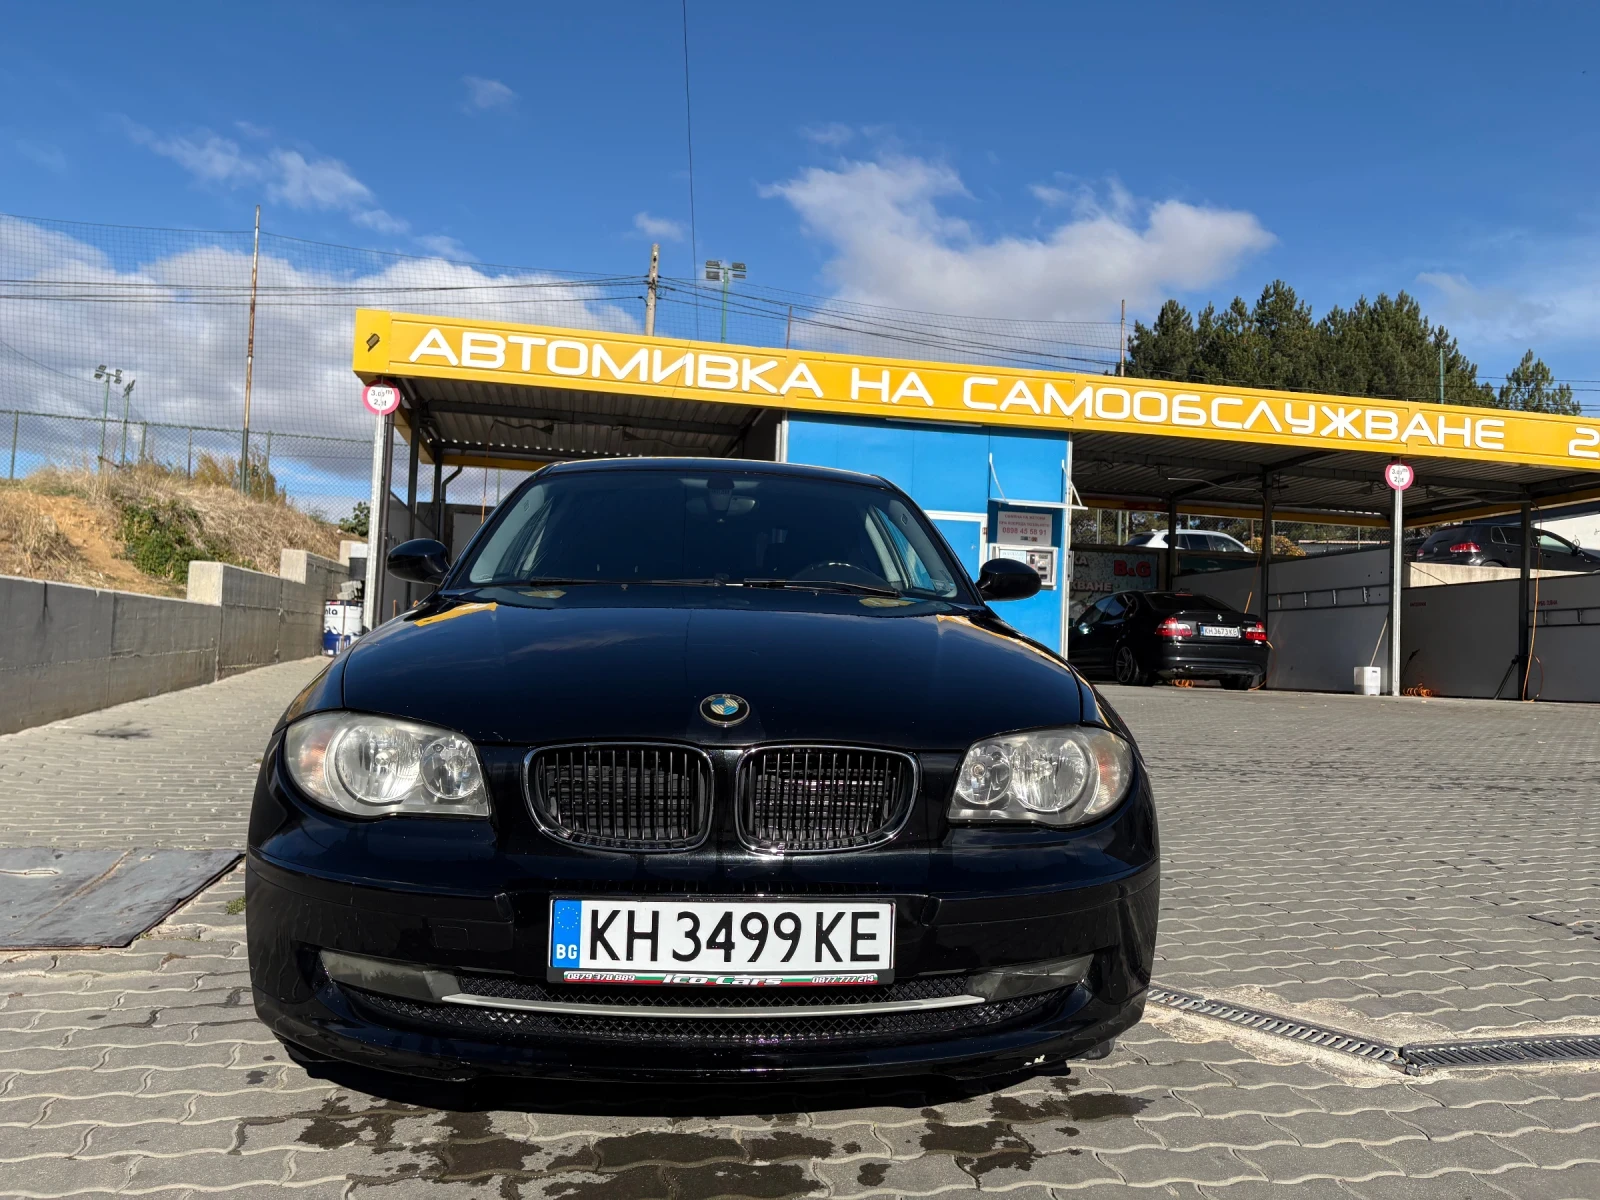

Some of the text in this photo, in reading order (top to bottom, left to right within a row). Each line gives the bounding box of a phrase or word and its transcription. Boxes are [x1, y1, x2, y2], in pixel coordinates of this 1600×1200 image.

[409, 327, 824, 398] АВТОМИВКА
[850, 367, 934, 407] НА
[963, 376, 1505, 450] САМООБСЛУЖВАНЕ
[556, 943, 578, 960] BG
[589, 909, 880, 963] KH 3499 KE
[715, 974, 783, 986] Cars
